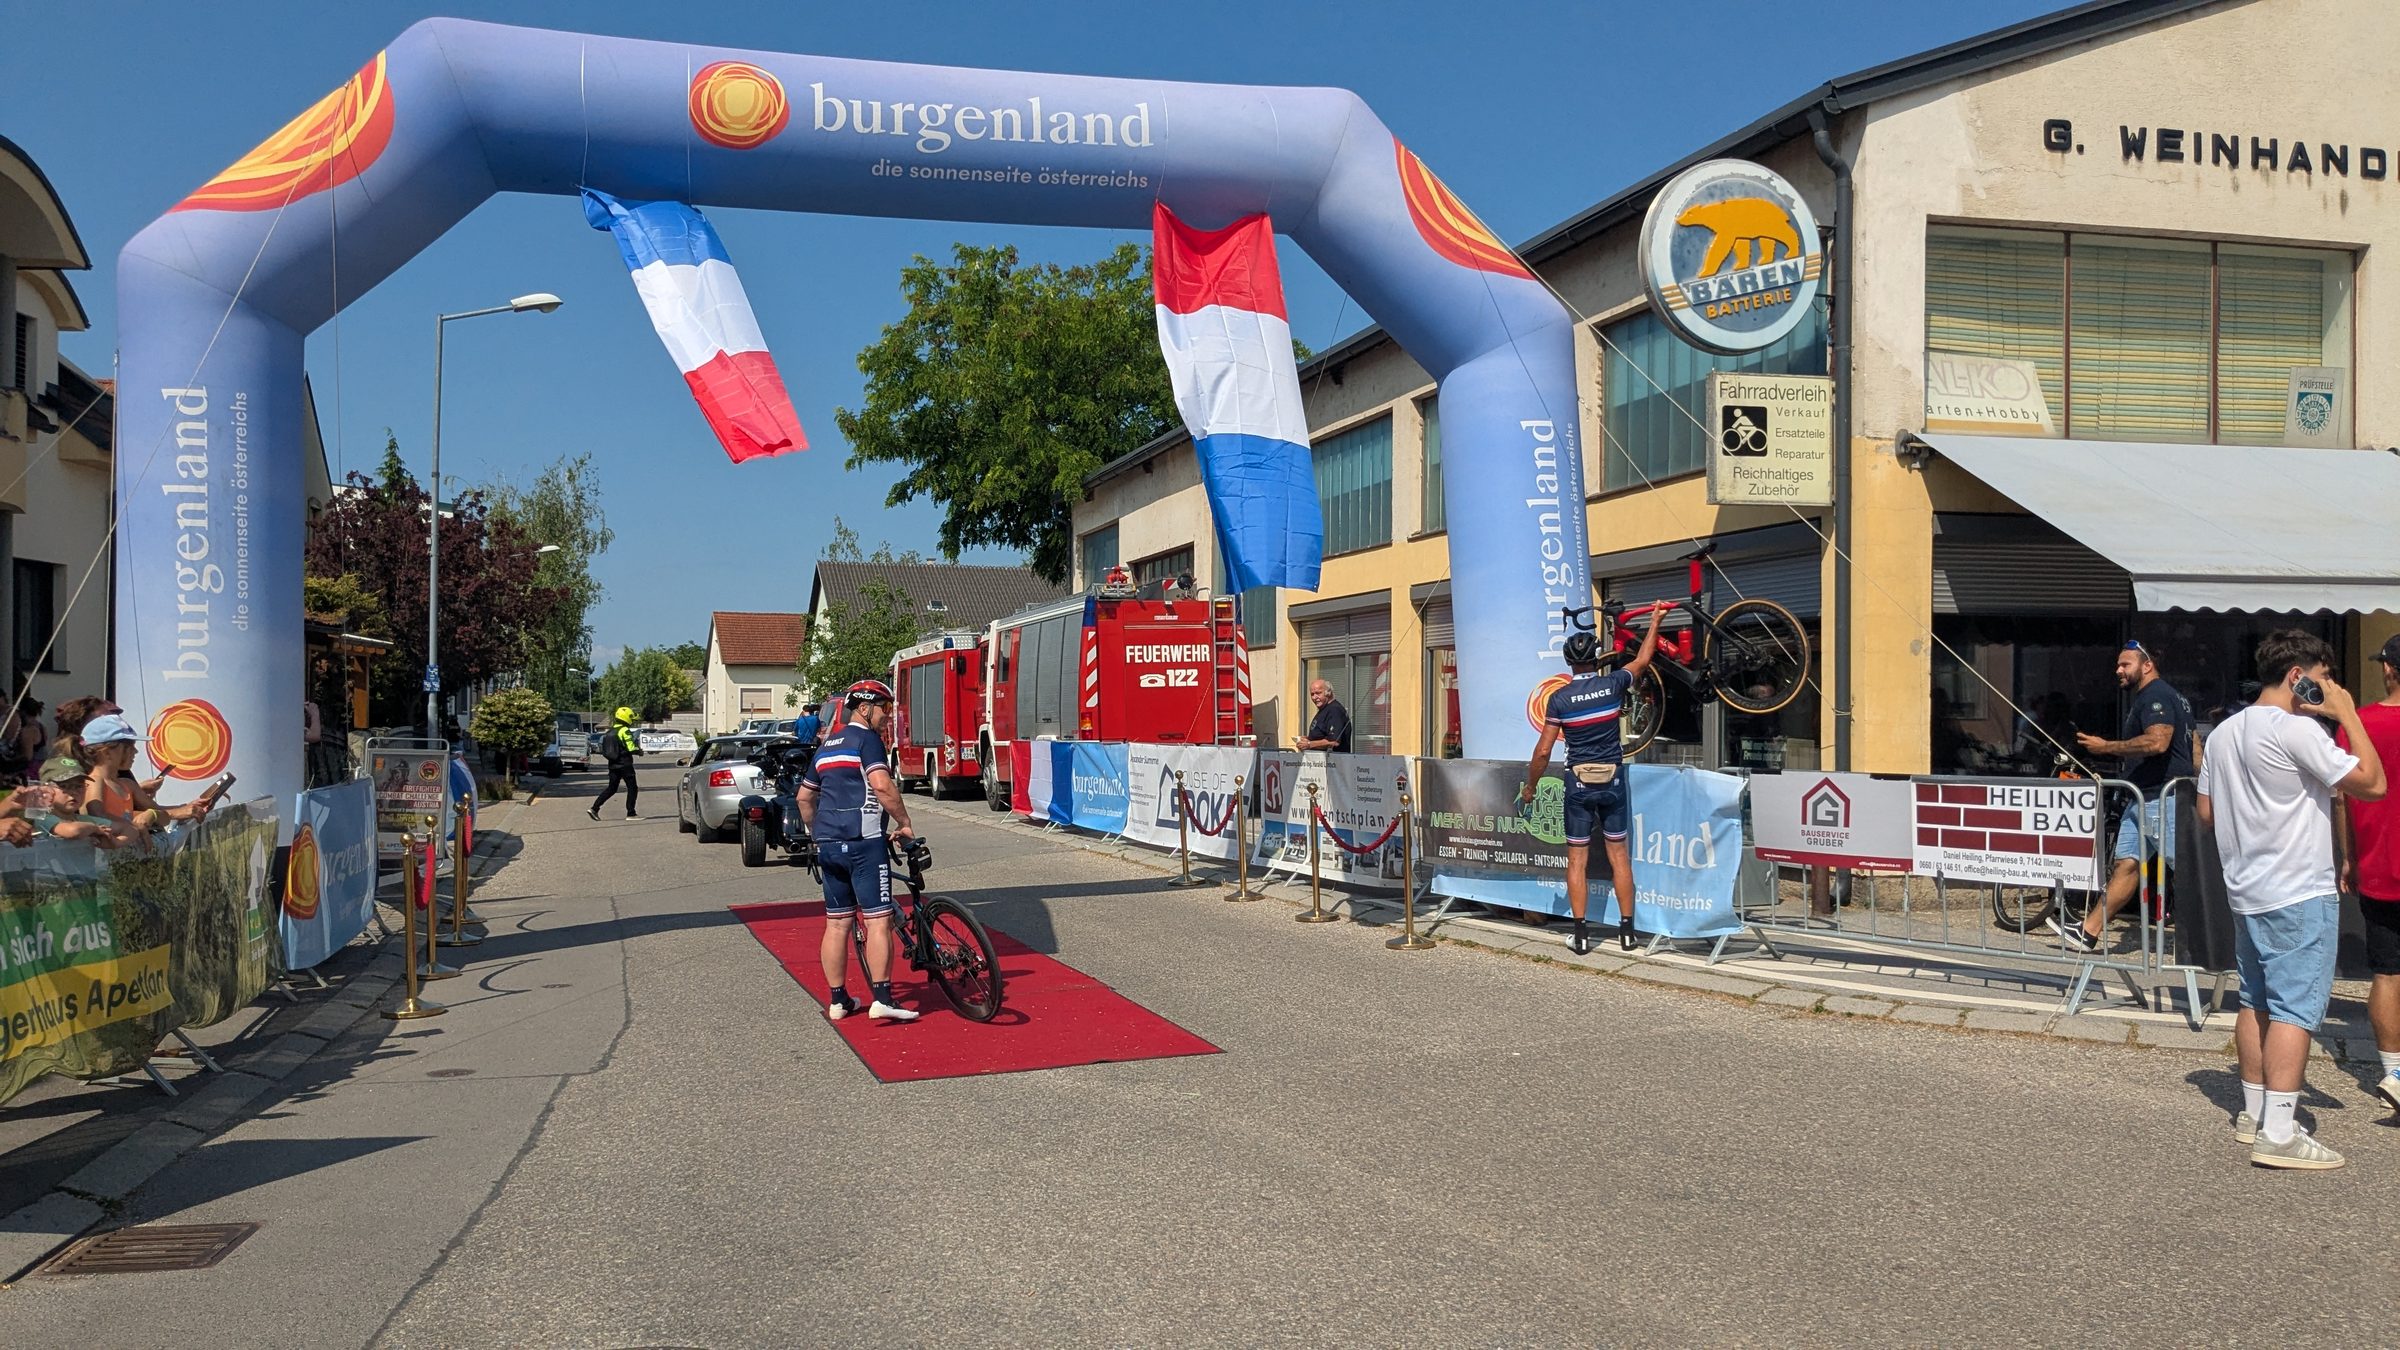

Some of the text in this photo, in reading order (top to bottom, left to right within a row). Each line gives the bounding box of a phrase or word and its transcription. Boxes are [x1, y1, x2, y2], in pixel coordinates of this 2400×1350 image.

[810, 82, 1154, 154] burgenland
[2044, 119, 2400, 181] G. WEINHAND
[871, 158, 1149, 189] die sonnenseite österreichs
[1691, 259, 1800, 304] BÄREN
[1706, 288, 1793, 320] BATTERIE
[1719, 381, 1827, 402] Fahrradverleih
[2299, 379, 2334, 390] PRÜFSTELLE
[1775, 406, 1826, 418] Verkauf
[1775, 428, 1826, 439] Ersatzteile
[1564, 422, 1580, 502] österreichs
[1775, 448, 1825, 460] Reparatur
[1733, 466, 1814, 483] Reichhaltiges
[1748, 483, 1800, 496] Zubehör
[230, 391, 249, 632] die sonnenseite österreichs
[161, 385, 225, 681] burgenland
[1520, 418, 1574, 662] burgenland
[1570, 505, 1587, 593] sonnenseite
[1125, 644, 1211, 664] FEUERWEHR
[1166, 669, 1199, 687] 122
[1570, 688, 1612, 703] FRANCE
[824, 737, 845, 747] FRANCE
[1072, 768, 1125, 802] burgenland
[1212, 773, 1228, 791] OF
[413, 801, 440, 809] AUSTRIA
[1990, 787, 2096, 811] HEILING
[1430, 811, 1465, 830] MEHR
[1467, 814, 1495, 832] ALS
[1497, 816, 1527, 834] NUR
[2033, 812, 2096, 834] BAU
[1801, 829, 1850, 840] BAUSERVICE
[1806, 837, 1844, 848] GRUBER
[1438, 846, 1457, 859] ESSEN
[1462, 847, 1488, 862] TRINKEN
[1494, 850, 1528, 865] SCHLAFEN
[1919, 860, 1932, 870] 0660
[1936, 862, 1943, 871] 63
[1944, 862, 1954, 872] 146
[1943, 850, 1961, 860] Daniel
[1961, 852, 1983, 864] Heiling,
[1985, 854, 2018, 865] Pfarrwiese
[2027, 857, 2042, 867] 7142
[879, 863, 890, 903] FRANCE
[1635, 885, 1713, 911] österreichs
[11, 920, 53, 967] sich
[63, 920, 112, 954] aus
[86, 964, 165, 1018] Apetlon
